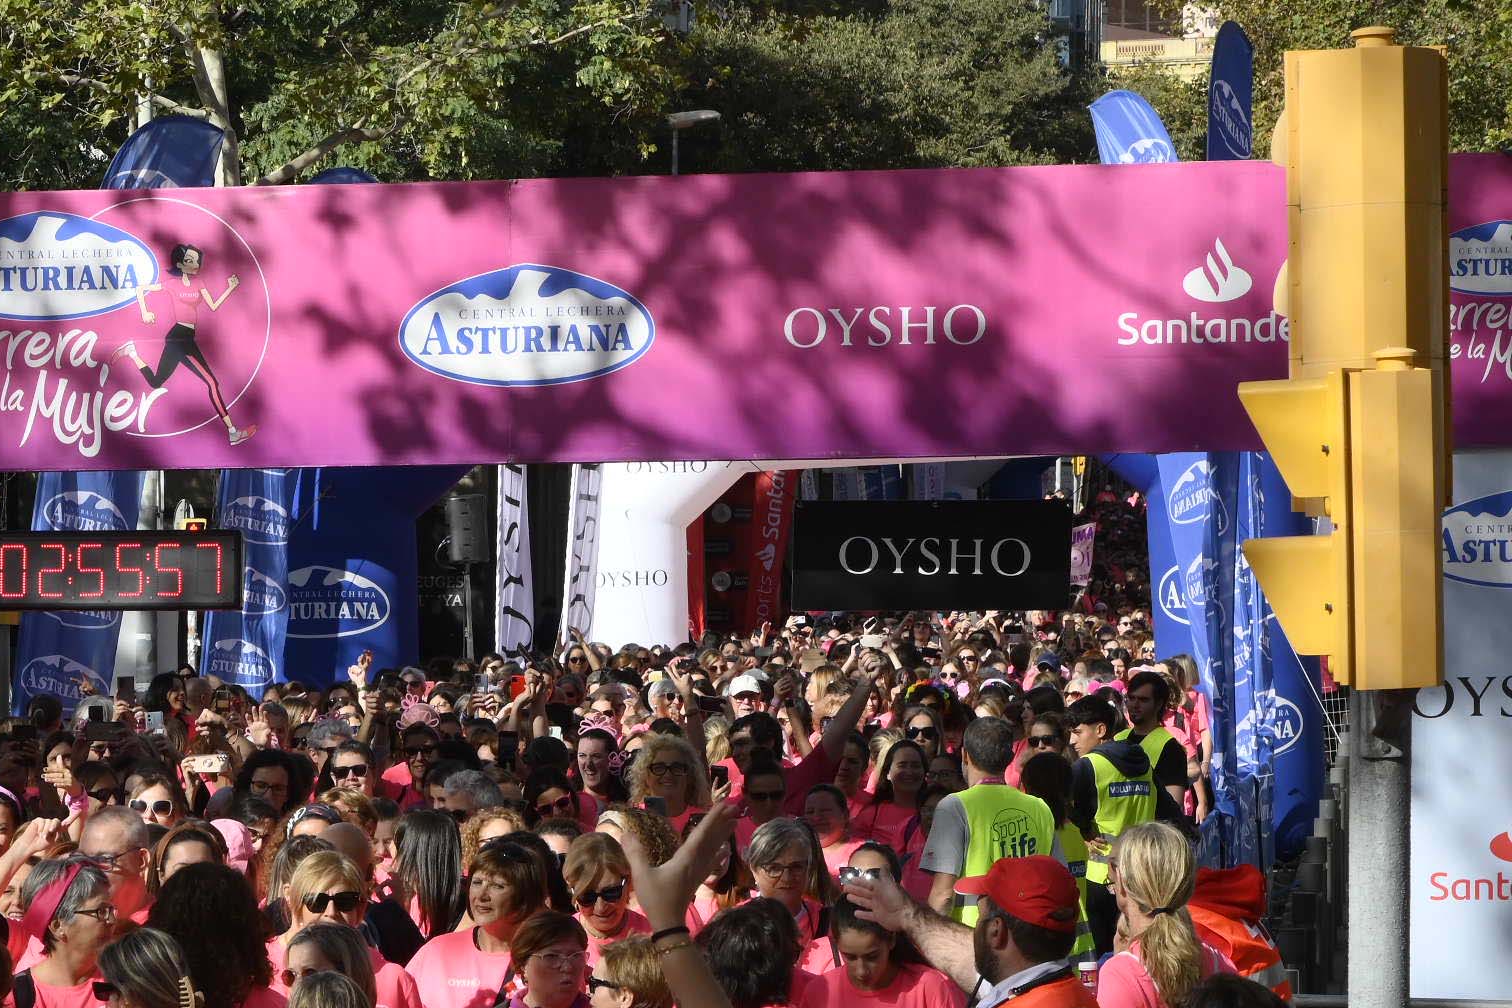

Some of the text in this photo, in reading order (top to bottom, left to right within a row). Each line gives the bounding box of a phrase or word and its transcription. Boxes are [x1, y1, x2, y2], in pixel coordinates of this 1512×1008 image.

[61, 248, 135, 259] LECHERA
[458, 305, 627, 321] CENTRAL LECHERA
[783, 304, 988, 348] OYSHO
[1118, 311, 1288, 346] Santande
[419, 311, 633, 355] ASTURIANA
[0, 371, 25, 412] la
[19, 364, 169, 458] Mujer
[0, 543, 223, 598] 02:55:57
[838, 535, 1032, 577] OYSHO
[287, 602, 381, 621] TURIANA
[992, 814, 1030, 842] Sport
[999, 832, 1038, 858] Life
[1430, 872, 1512, 901] Sant
